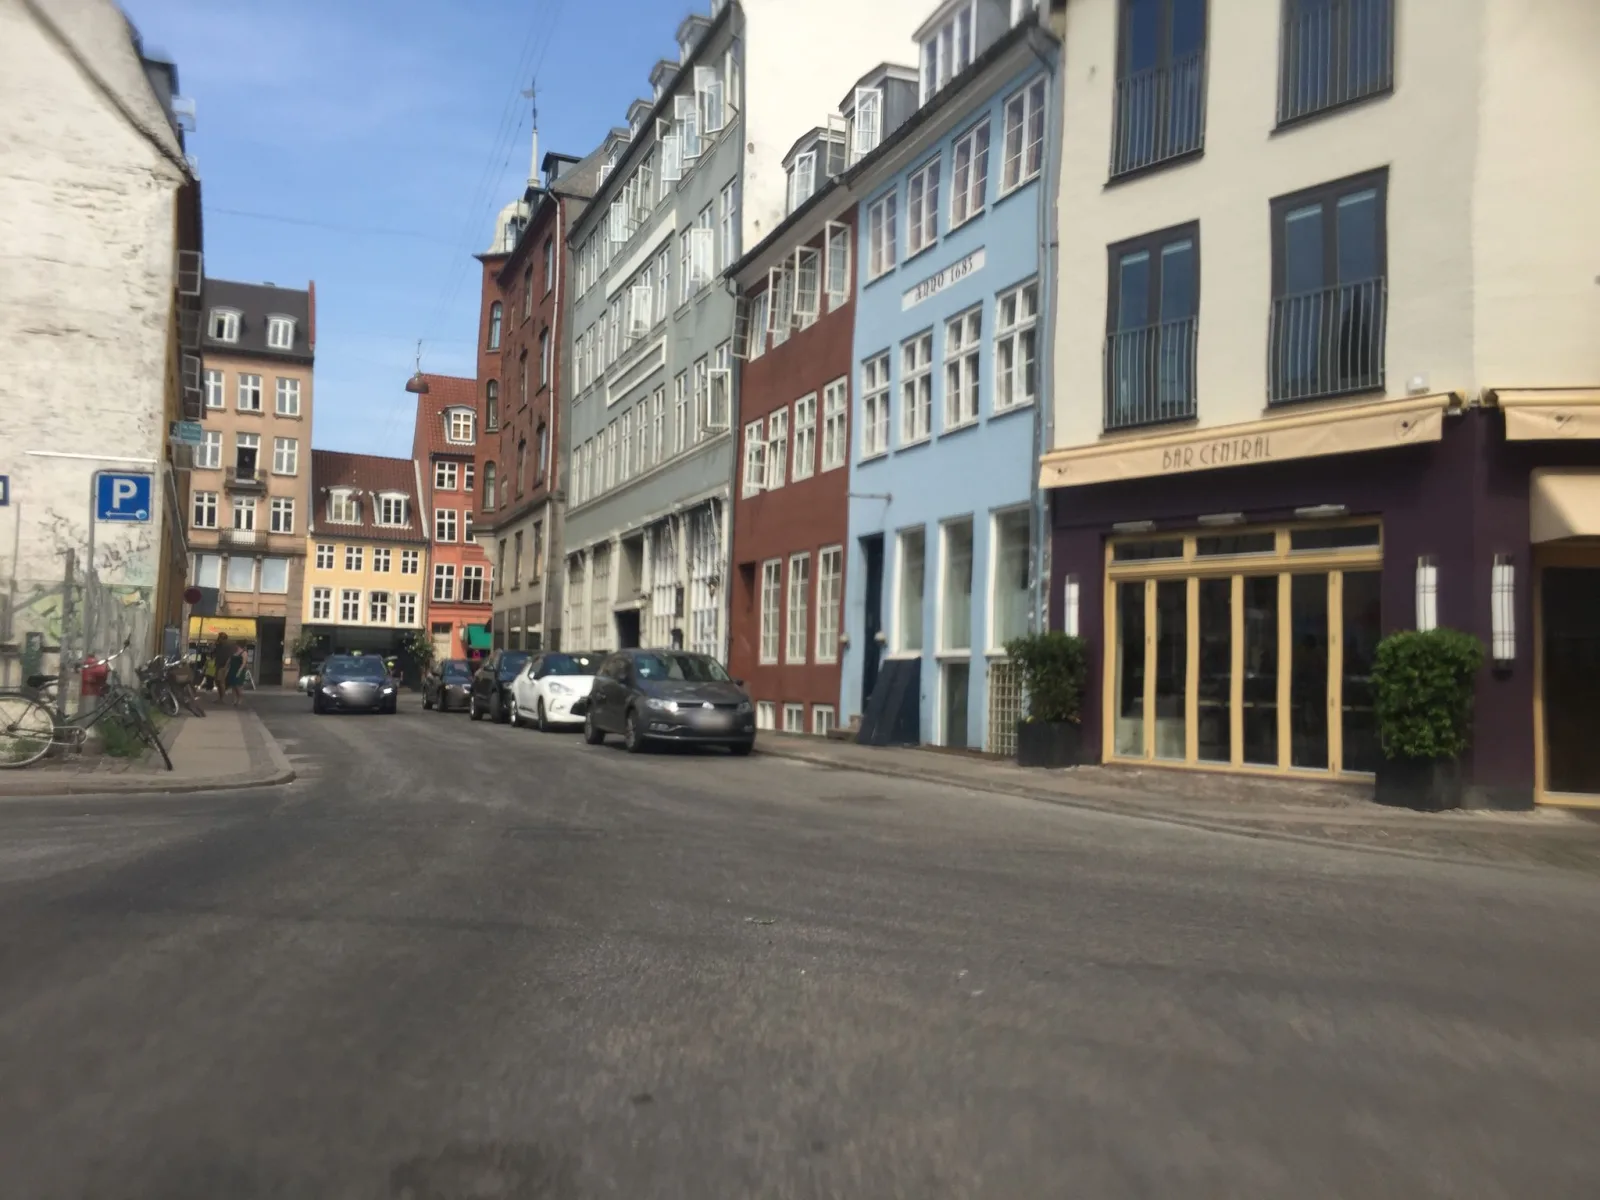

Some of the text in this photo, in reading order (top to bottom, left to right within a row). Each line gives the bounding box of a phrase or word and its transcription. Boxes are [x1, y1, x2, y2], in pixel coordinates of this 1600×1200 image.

[1162, 435, 1271, 470] BAR CENTRAL
[112, 478, 138, 509] P
